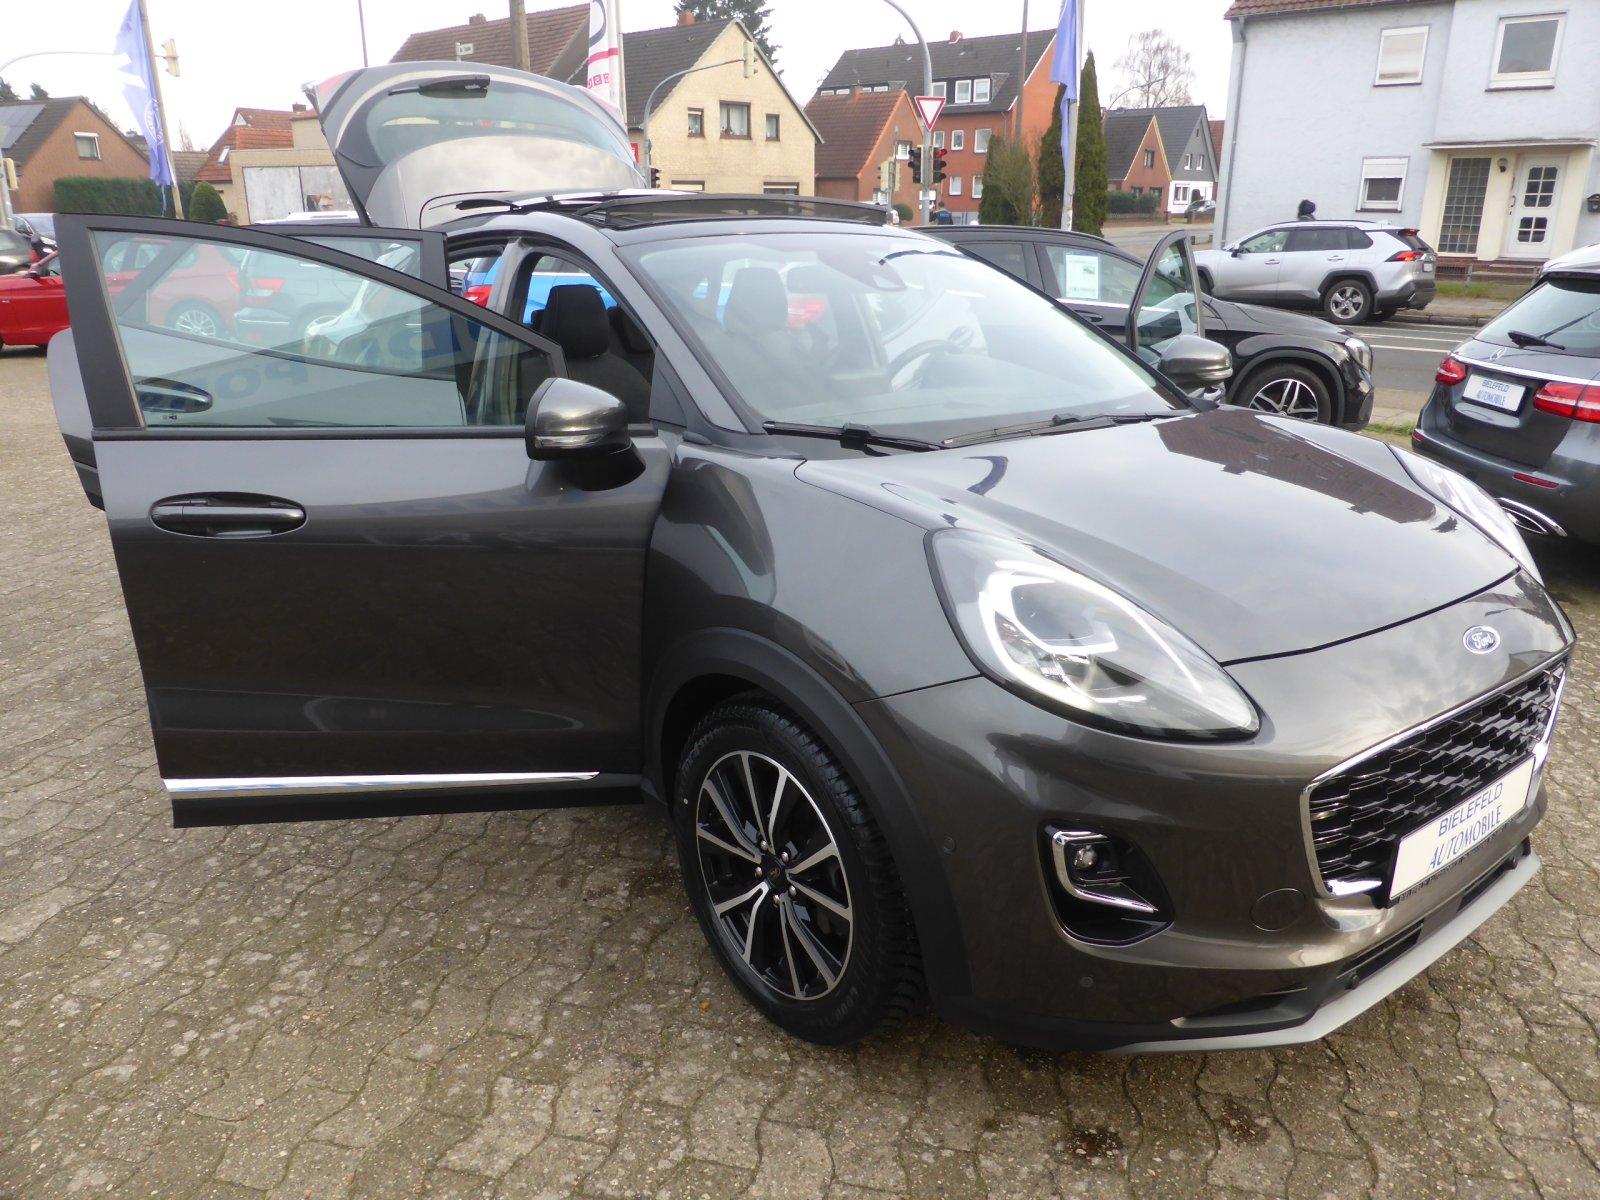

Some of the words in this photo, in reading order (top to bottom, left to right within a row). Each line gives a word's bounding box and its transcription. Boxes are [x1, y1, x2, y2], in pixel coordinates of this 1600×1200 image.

[1468, 630, 1495, 650] Ford
[1429, 804, 1502, 870] AUTOMOBILE
[1438, 782, 1503, 837] BIELEFELD
